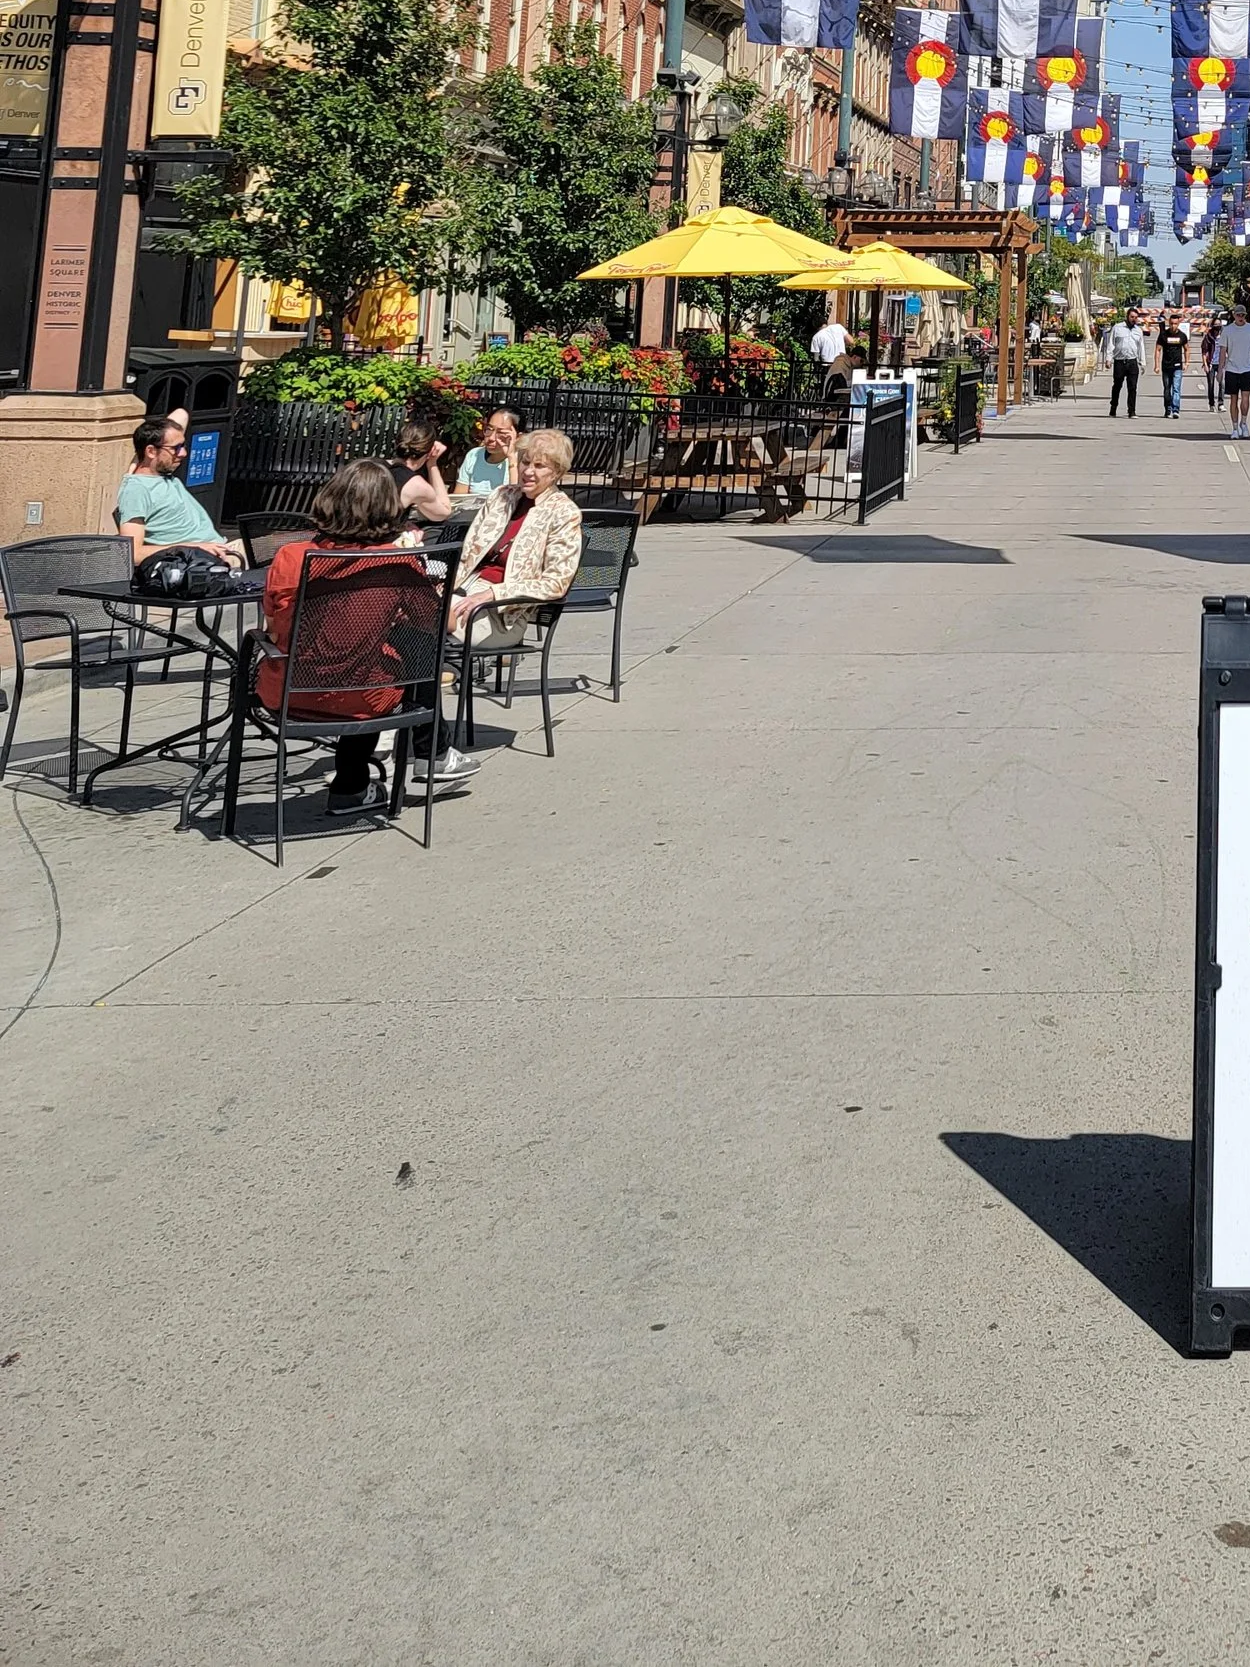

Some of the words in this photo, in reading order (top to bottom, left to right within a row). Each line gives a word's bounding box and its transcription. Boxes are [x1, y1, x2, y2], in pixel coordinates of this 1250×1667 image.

[0, 14, 57, 30] EQUITY
[0, 32, 12, 46] S
[16, 33, 51, 48] OUR
[700, 160, 711, 196] Denver
